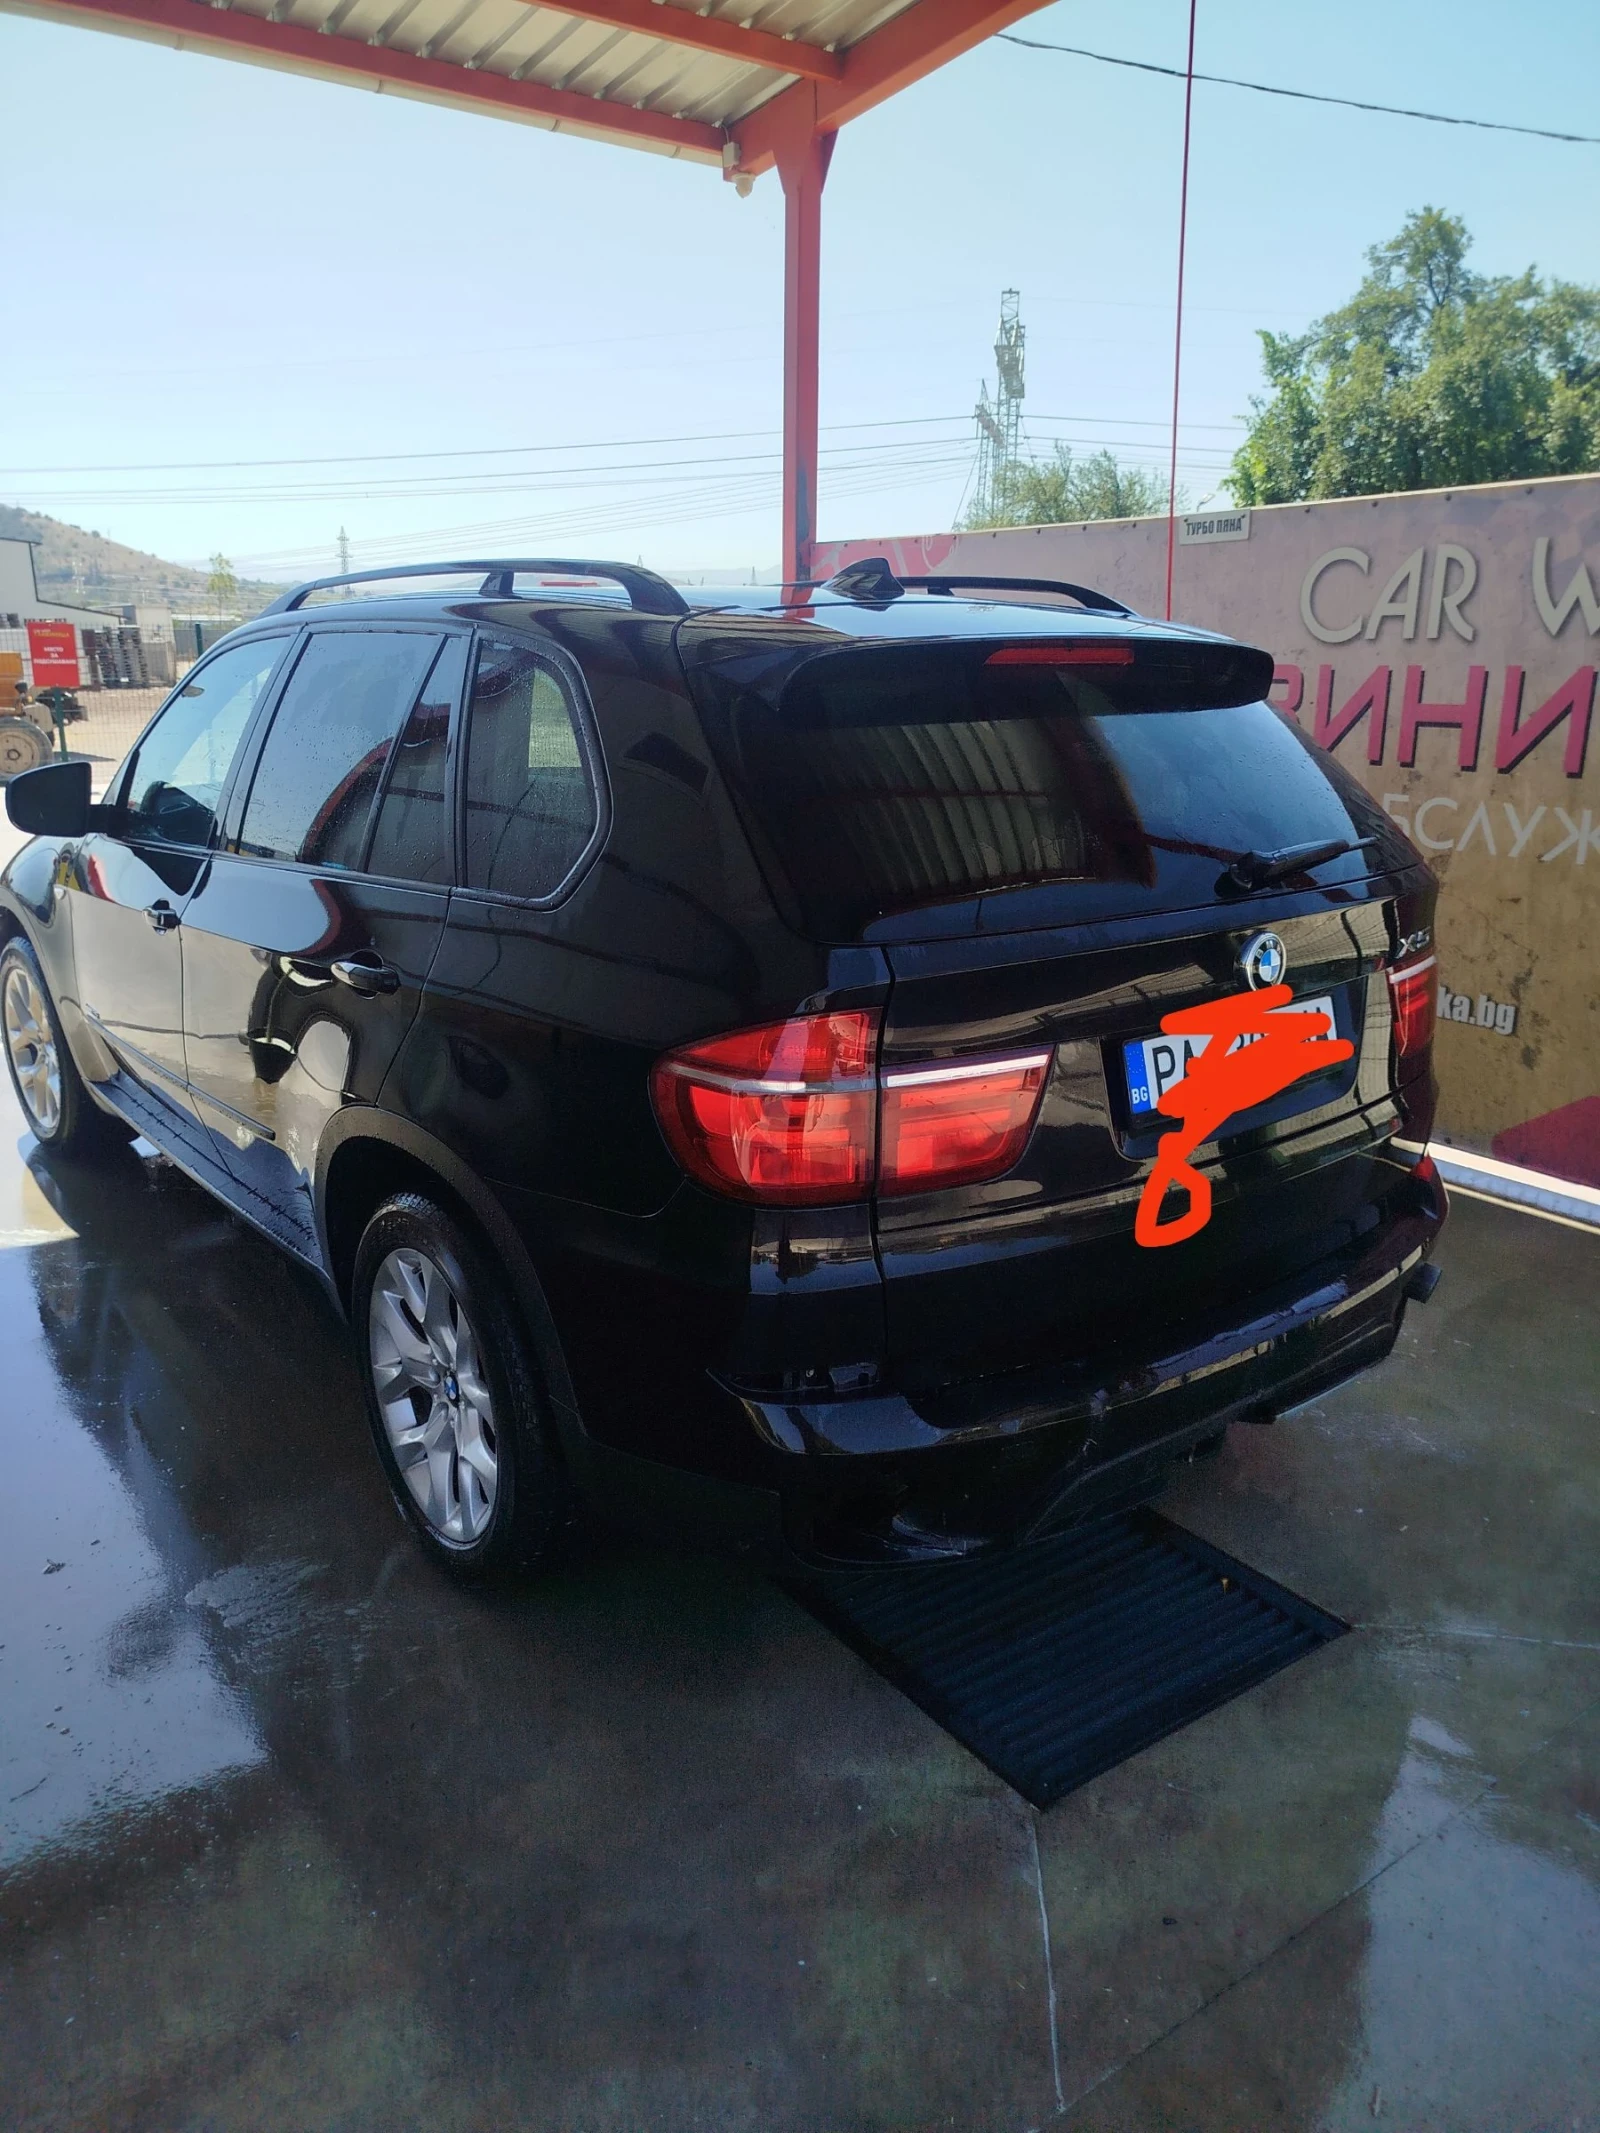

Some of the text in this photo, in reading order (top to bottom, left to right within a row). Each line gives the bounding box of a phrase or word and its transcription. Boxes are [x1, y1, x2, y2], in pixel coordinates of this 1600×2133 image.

[1186, 517, 1242, 536] ТУРБО ПЯНА
[1300, 544, 1478, 643] CAR
[1395, 926, 1430, 959] X5
[1131, 1086, 1149, 1105] BG
